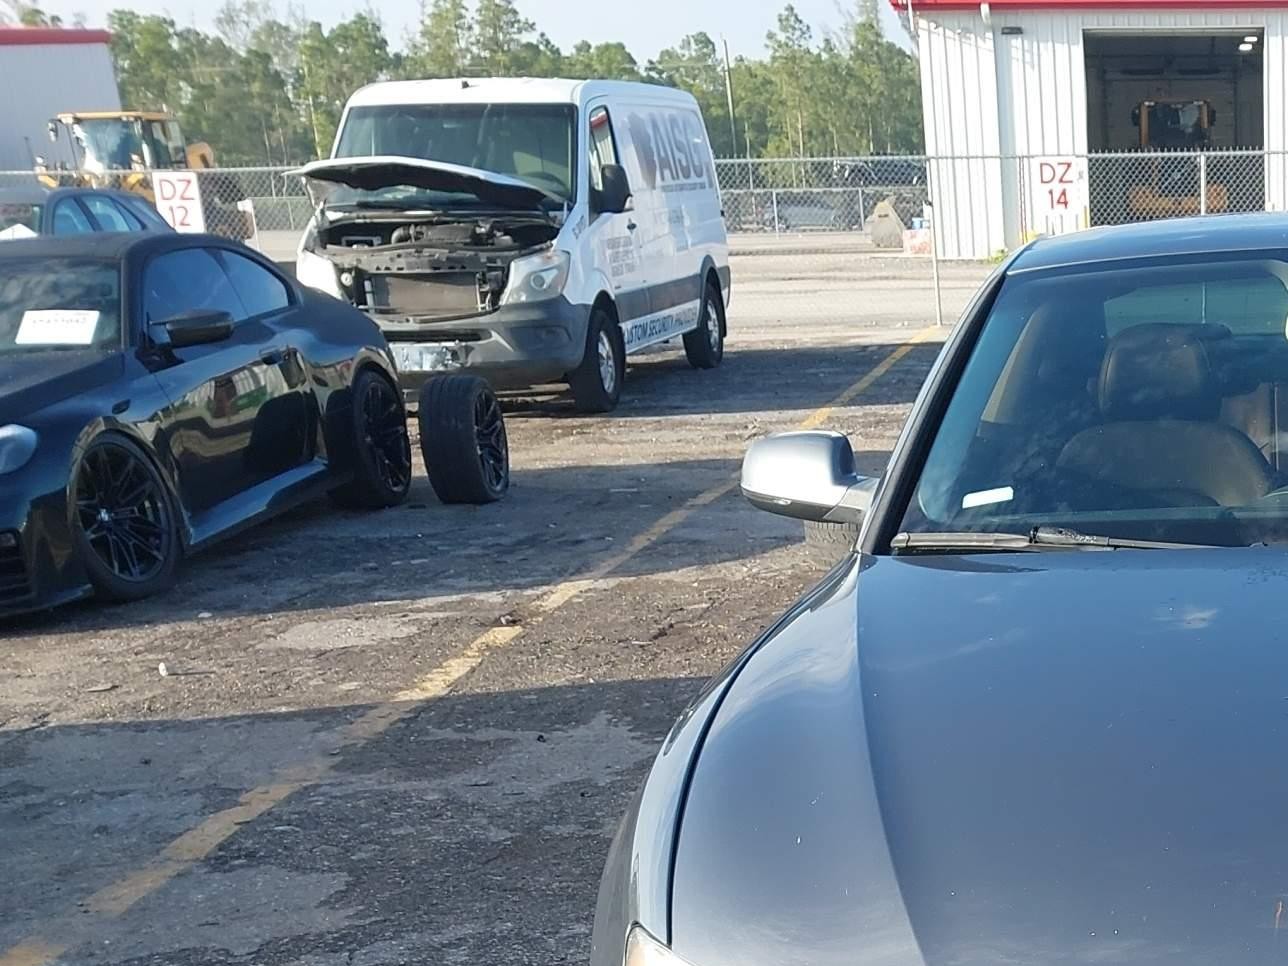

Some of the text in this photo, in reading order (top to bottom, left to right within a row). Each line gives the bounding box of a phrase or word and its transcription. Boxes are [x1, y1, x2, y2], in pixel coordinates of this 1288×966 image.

[1039, 162, 1073, 184] DZ
[158, 178, 196, 201] DZ
[1048, 188, 1069, 210] 14
[168, 205, 192, 228] 12
